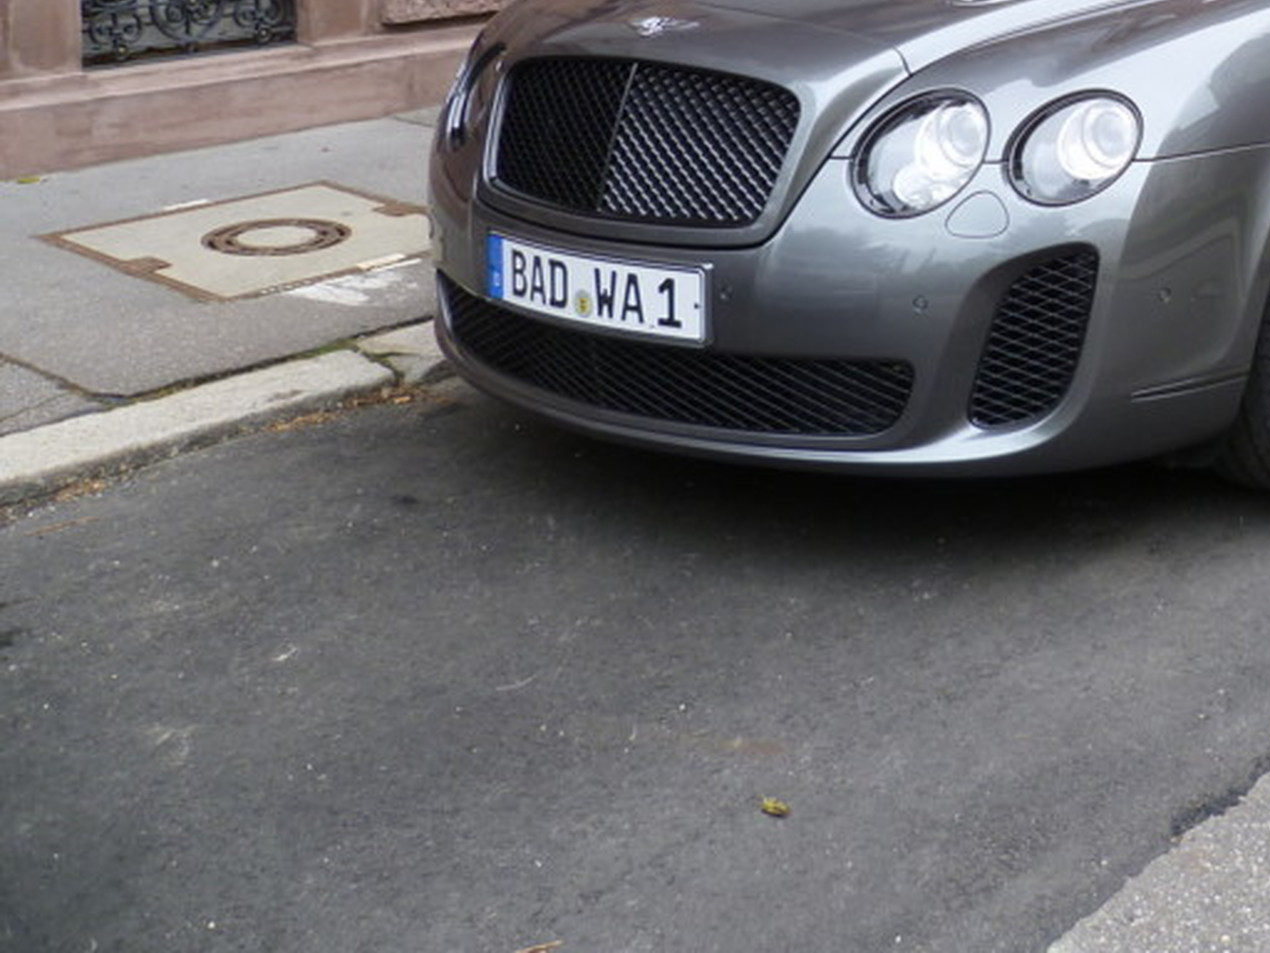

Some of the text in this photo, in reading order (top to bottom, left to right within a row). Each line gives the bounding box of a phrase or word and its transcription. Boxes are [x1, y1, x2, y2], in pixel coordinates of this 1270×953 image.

[511, 250, 682, 328] BAD WA 1
